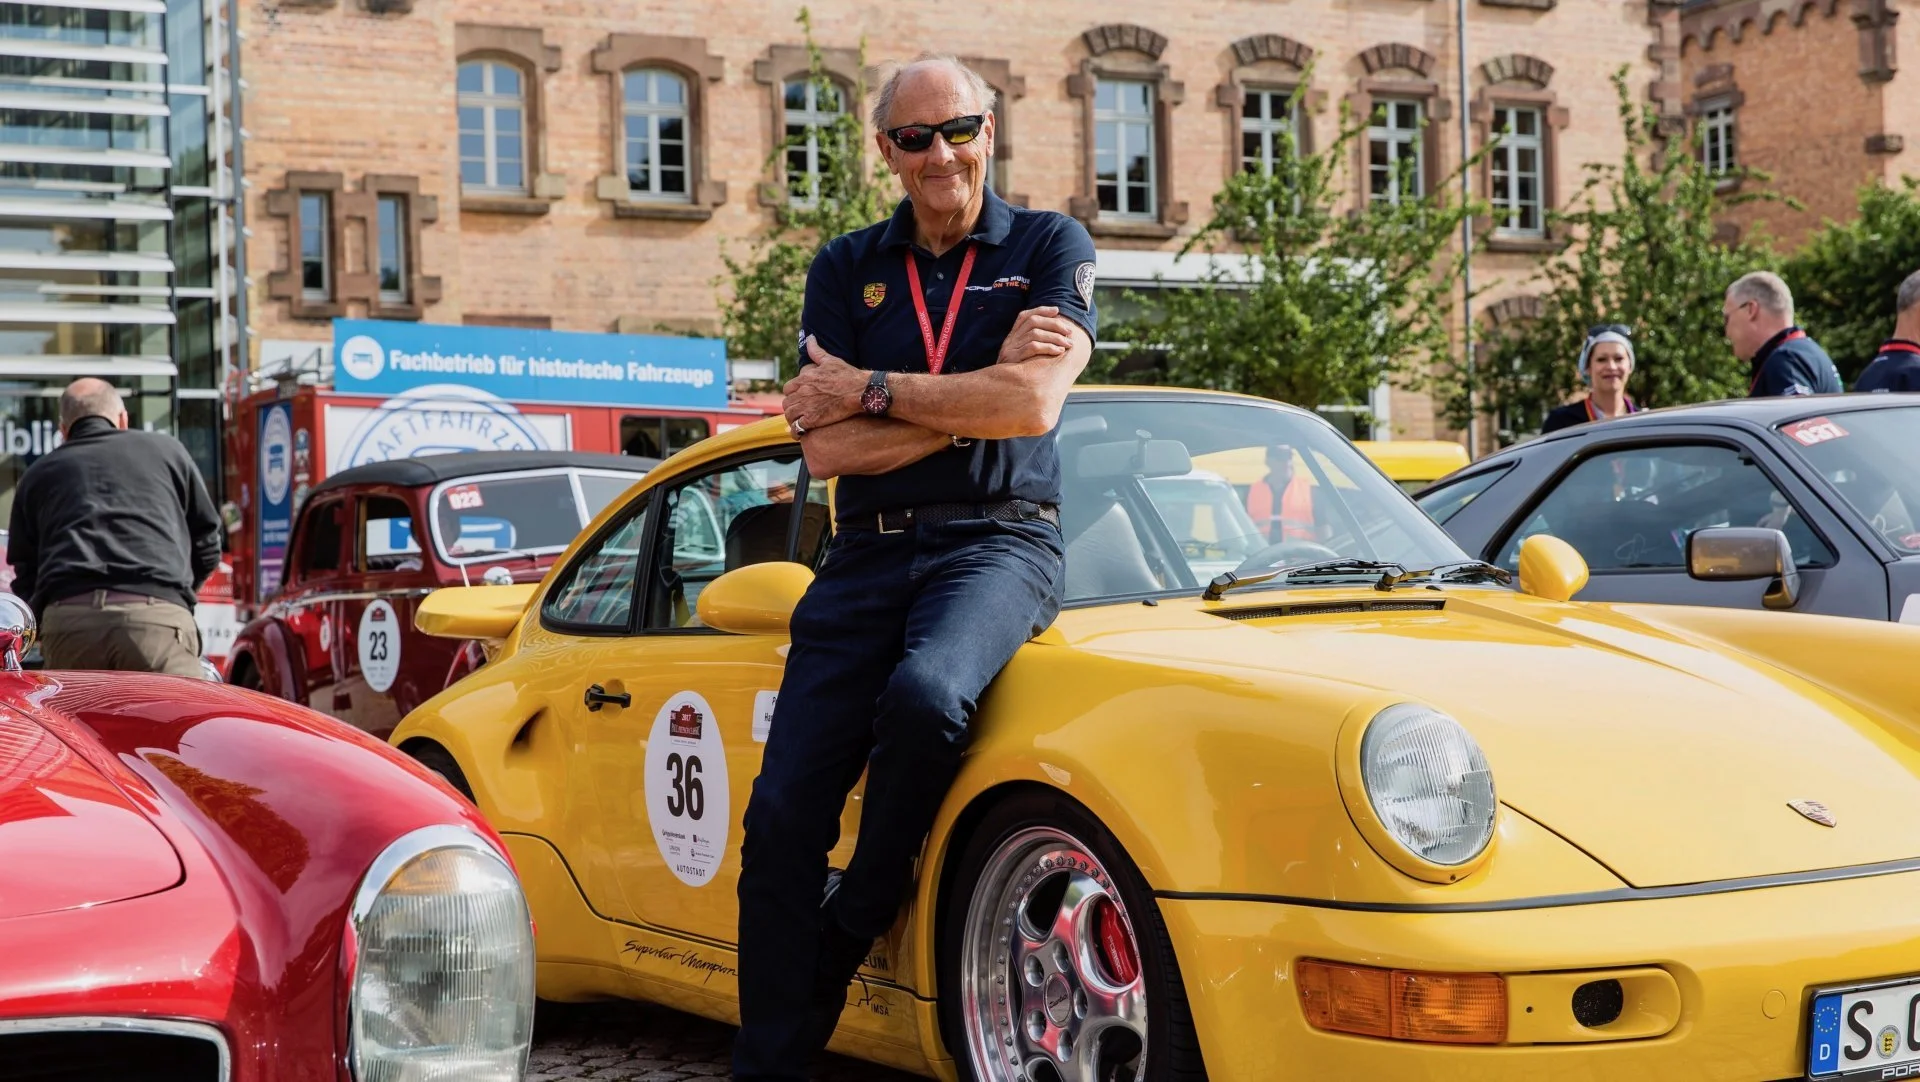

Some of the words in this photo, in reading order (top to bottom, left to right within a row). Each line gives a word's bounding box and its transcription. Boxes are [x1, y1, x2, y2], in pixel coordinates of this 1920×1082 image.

[389, 349, 496, 375] Fachbetrieb
[499, 355, 526, 376] für
[528, 356, 624, 381] historische
[627, 361, 714, 389] Fahrzeuge
[369, 631, 388, 660] 23
[666, 752, 704, 820] 36
[677, 864, 706, 877] AUTOSTADT
[1844, 1000, 1873, 1060] S
[1819, 1044, 1830, 1060] D
